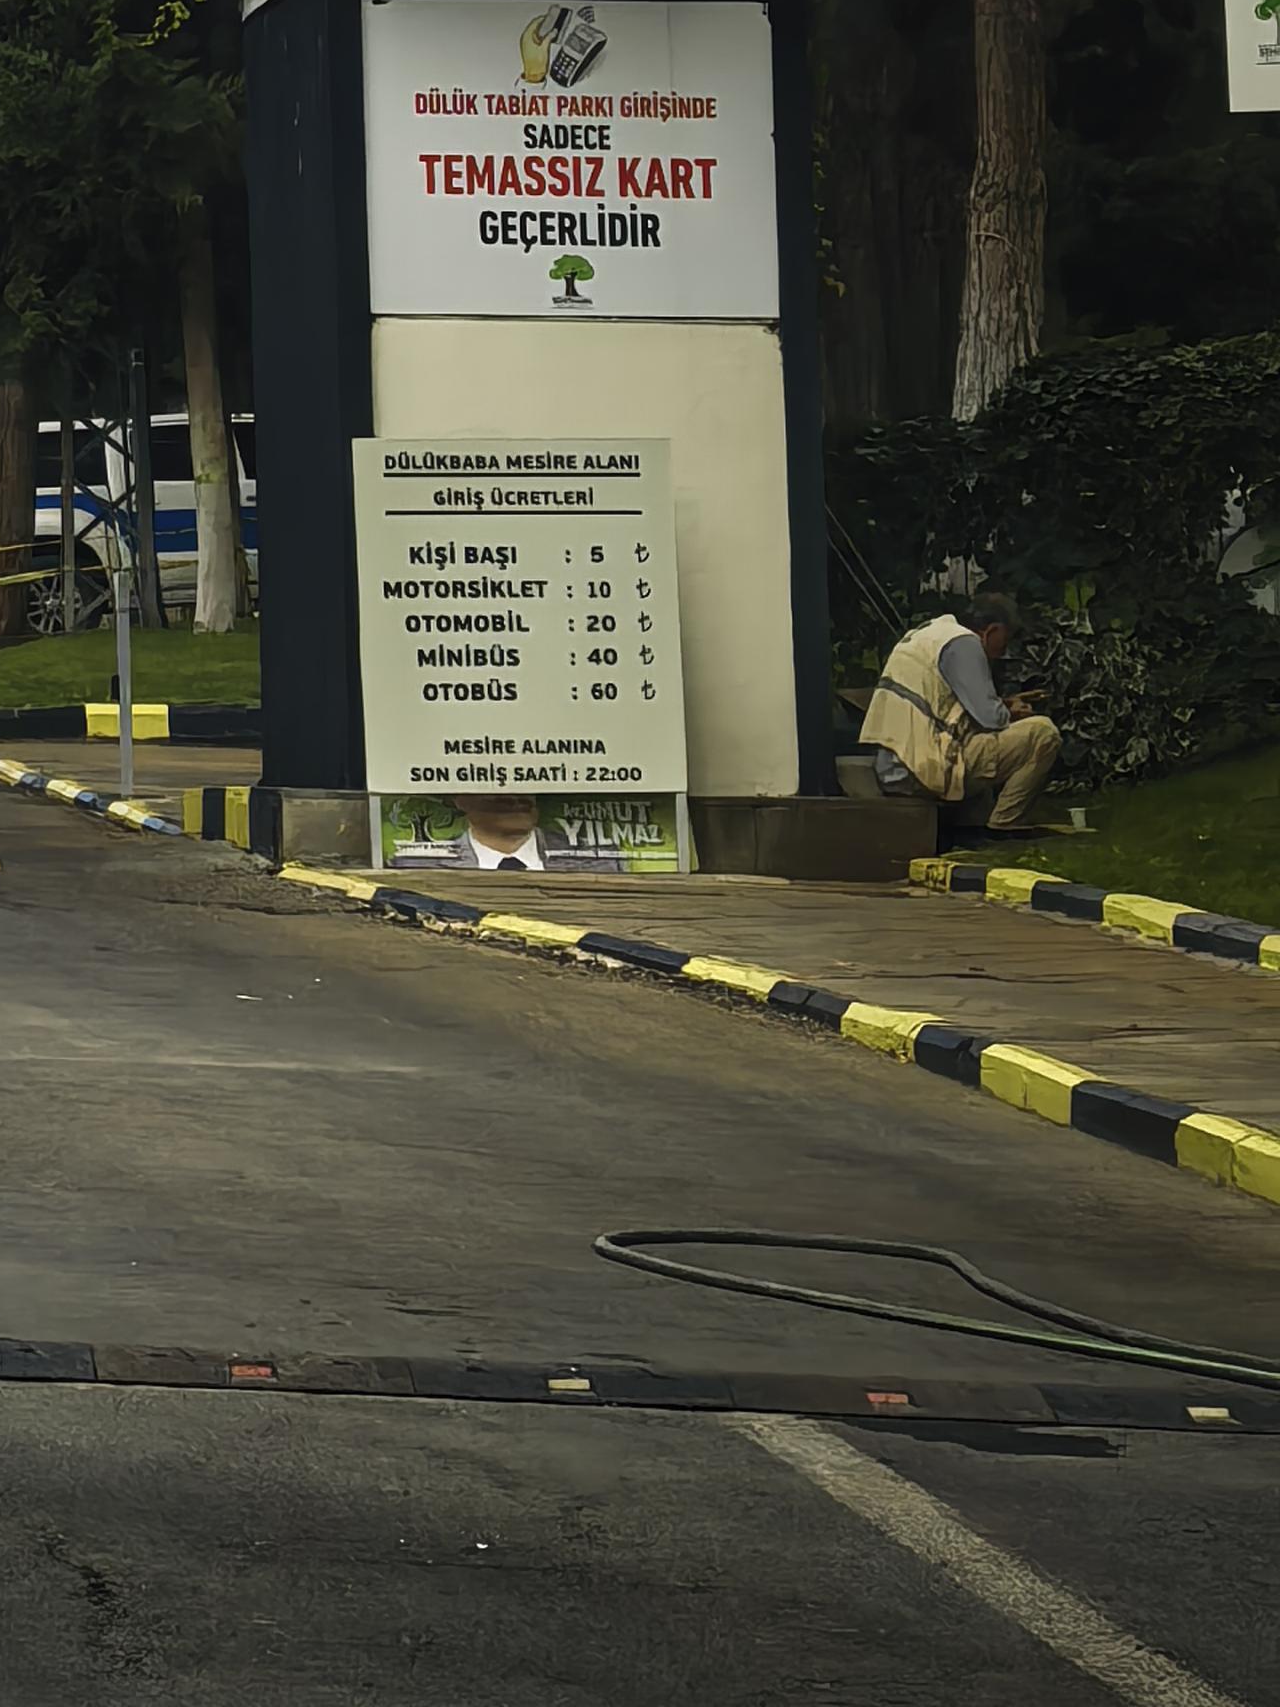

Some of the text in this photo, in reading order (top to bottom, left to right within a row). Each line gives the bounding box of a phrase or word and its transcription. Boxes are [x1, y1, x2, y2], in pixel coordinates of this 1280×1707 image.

[415, 87, 717, 122] DÜLÜK TABİAT PARKI GİRİŞİNDE
[523, 123, 611, 150] SADECE
[419, 154, 717, 199] TEMASSIZ KART
[479, 203, 661, 253] GEÇERLİDİR
[384, 451, 640, 470] DÜLÜKBABA MESİRE ALANI
[433, 487, 594, 510] GİRİŞ ÜCRETLERİ
[408, 541, 456, 570] KİŞİ
[464, 546, 517, 570] BAŞI
[590, 545, 605, 563] 5
[383, 576, 548, 599] MOTORSİKLET
[587, 581, 611, 599] 10
[405, 610, 530, 633] OTOMOBİL
[586, 615, 616, 633] 20
[417, 644, 520, 667] MİNİBÜS
[587, 648, 618, 666] 40
[422, 678, 518, 701] OTOBÜS
[590, 683, 618, 700] 60
[444, 736, 606, 755] MESİRE ALANINA
[410, 767, 450, 782] SON
[456, 763, 507, 786] GİRİŞ
[513, 763, 567, 781] SAATİ
[585, 766, 642, 781] 22:00
[554, 818, 664, 847] YILMAZ
